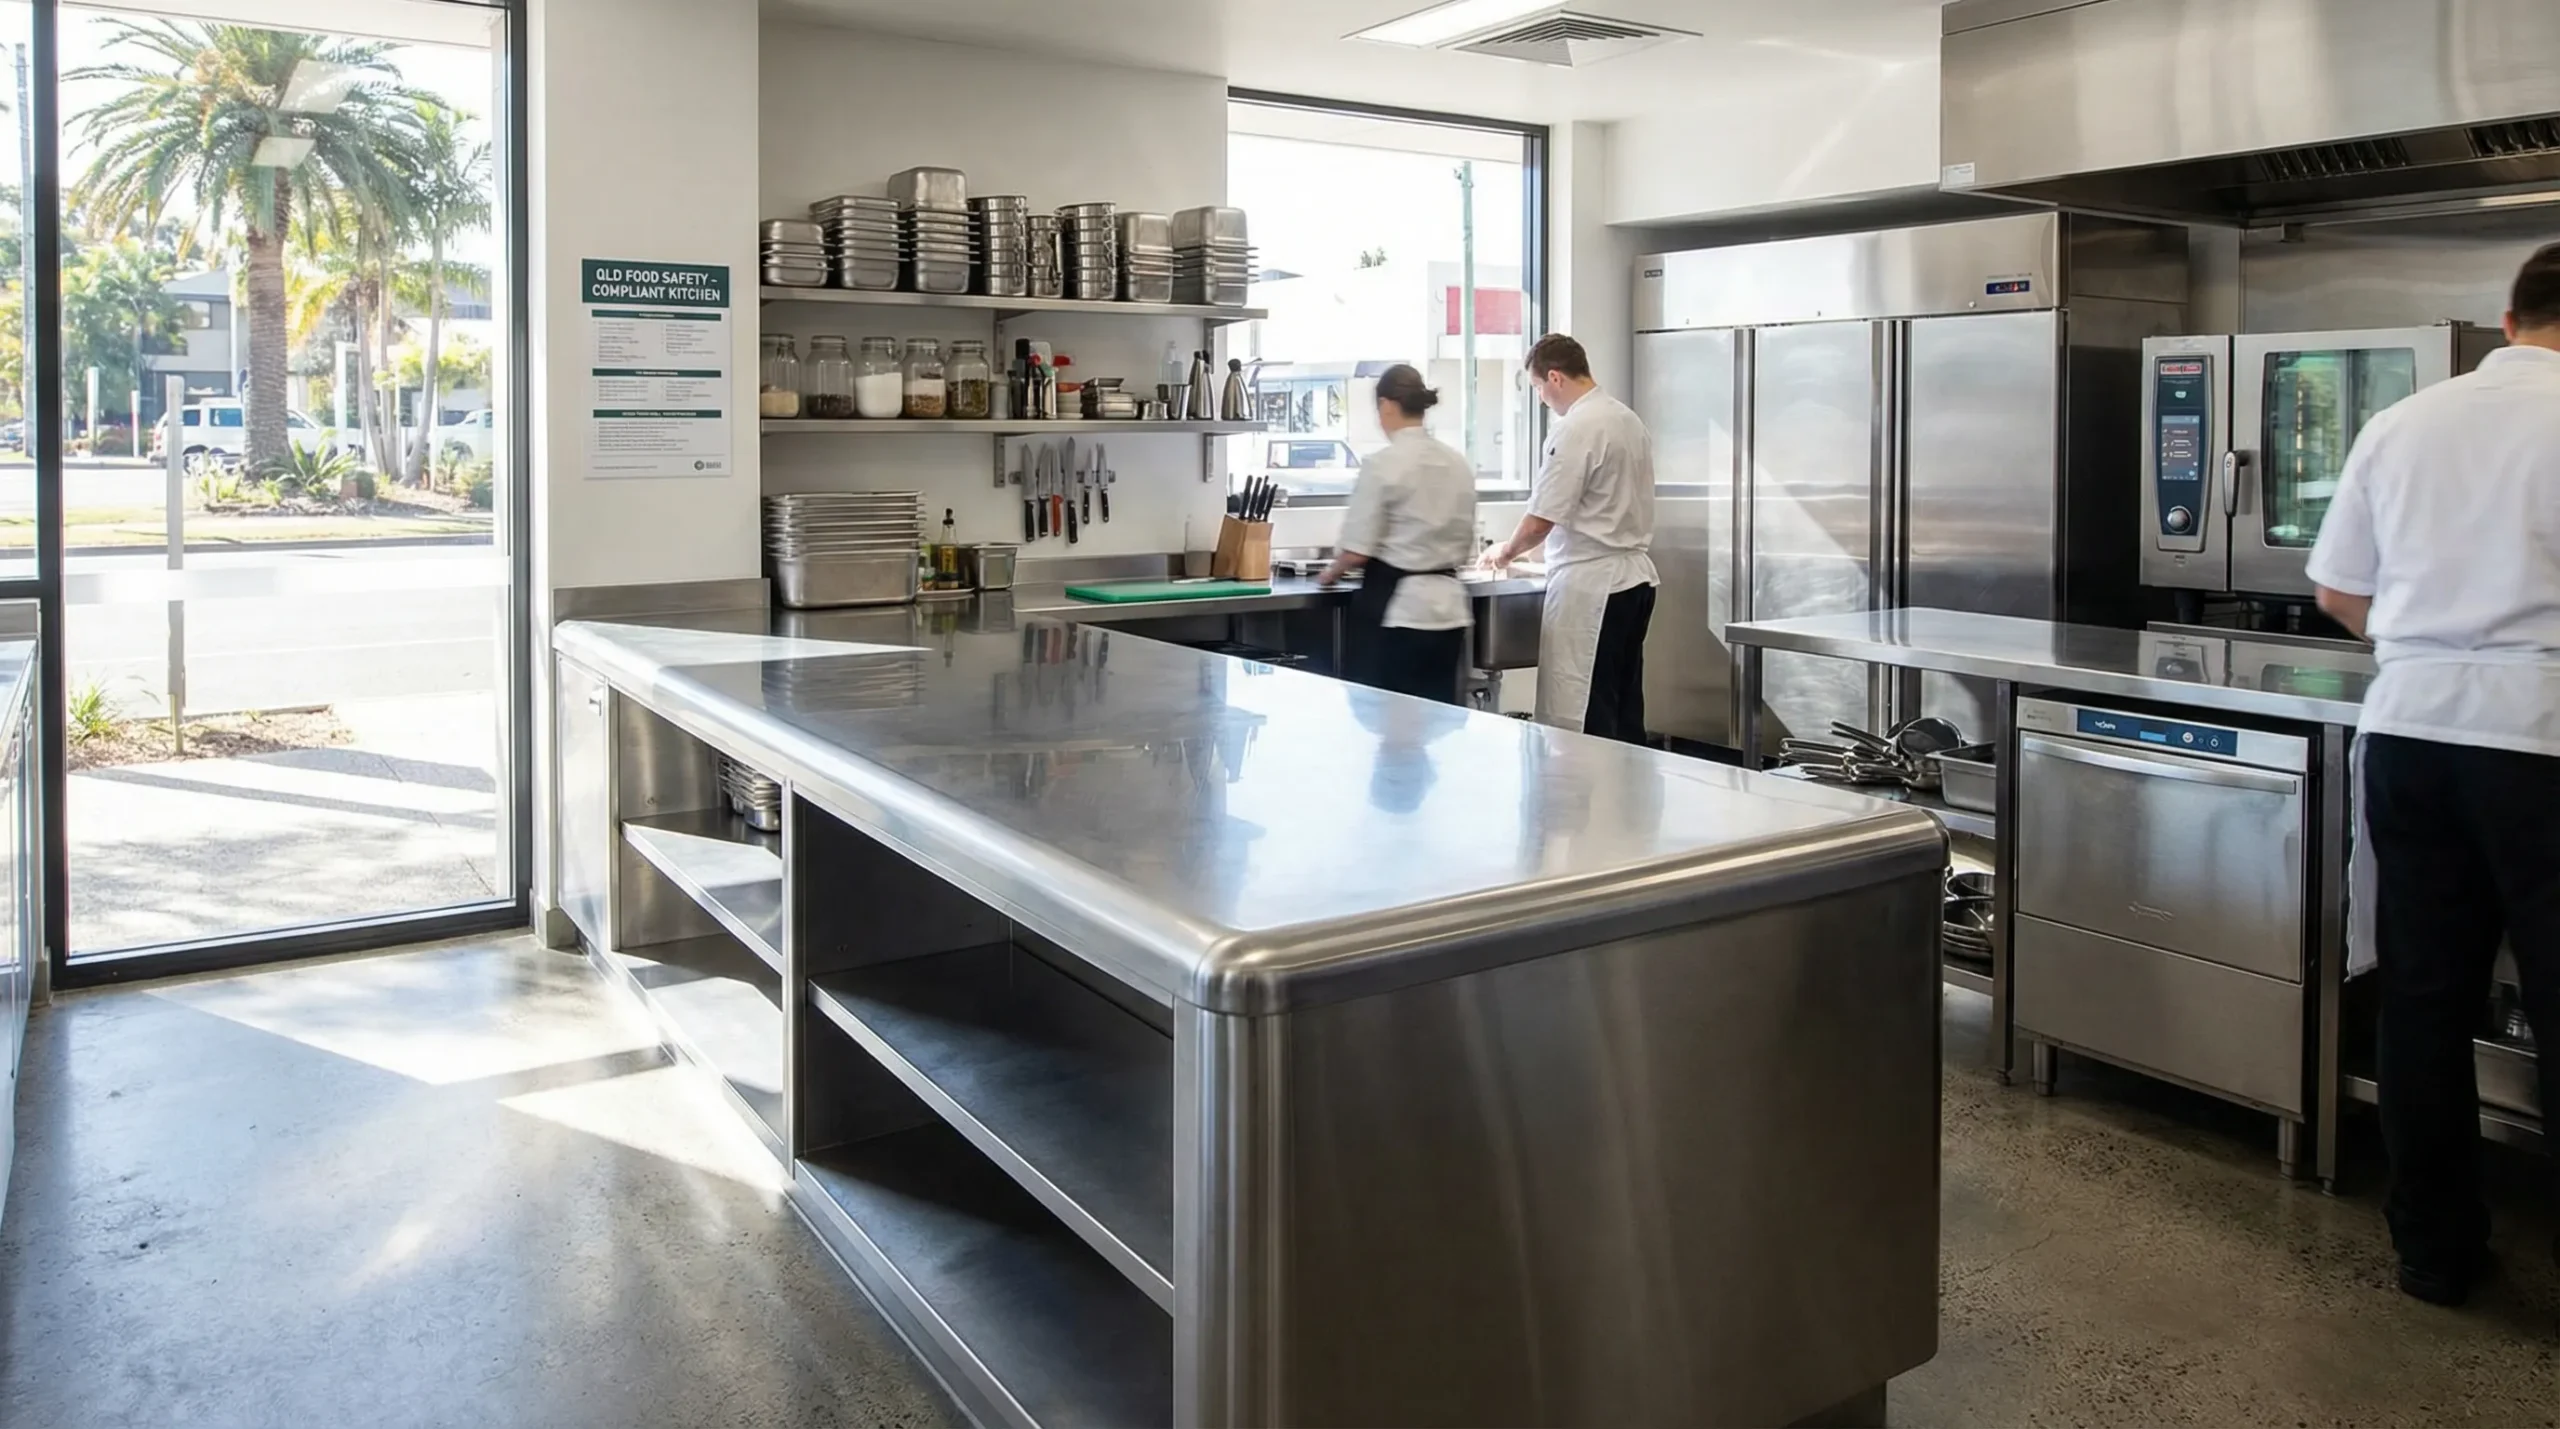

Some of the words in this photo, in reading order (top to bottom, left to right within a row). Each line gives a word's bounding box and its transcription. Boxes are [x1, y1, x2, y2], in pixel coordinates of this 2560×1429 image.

[596, 268, 622, 281] QLD
[625, 269, 659, 283] FOOD
[662, 271, 709, 285] SAFETY
[592, 284, 665, 299] COMPLIANT
[668, 287, 720, 301] KITCHEN
